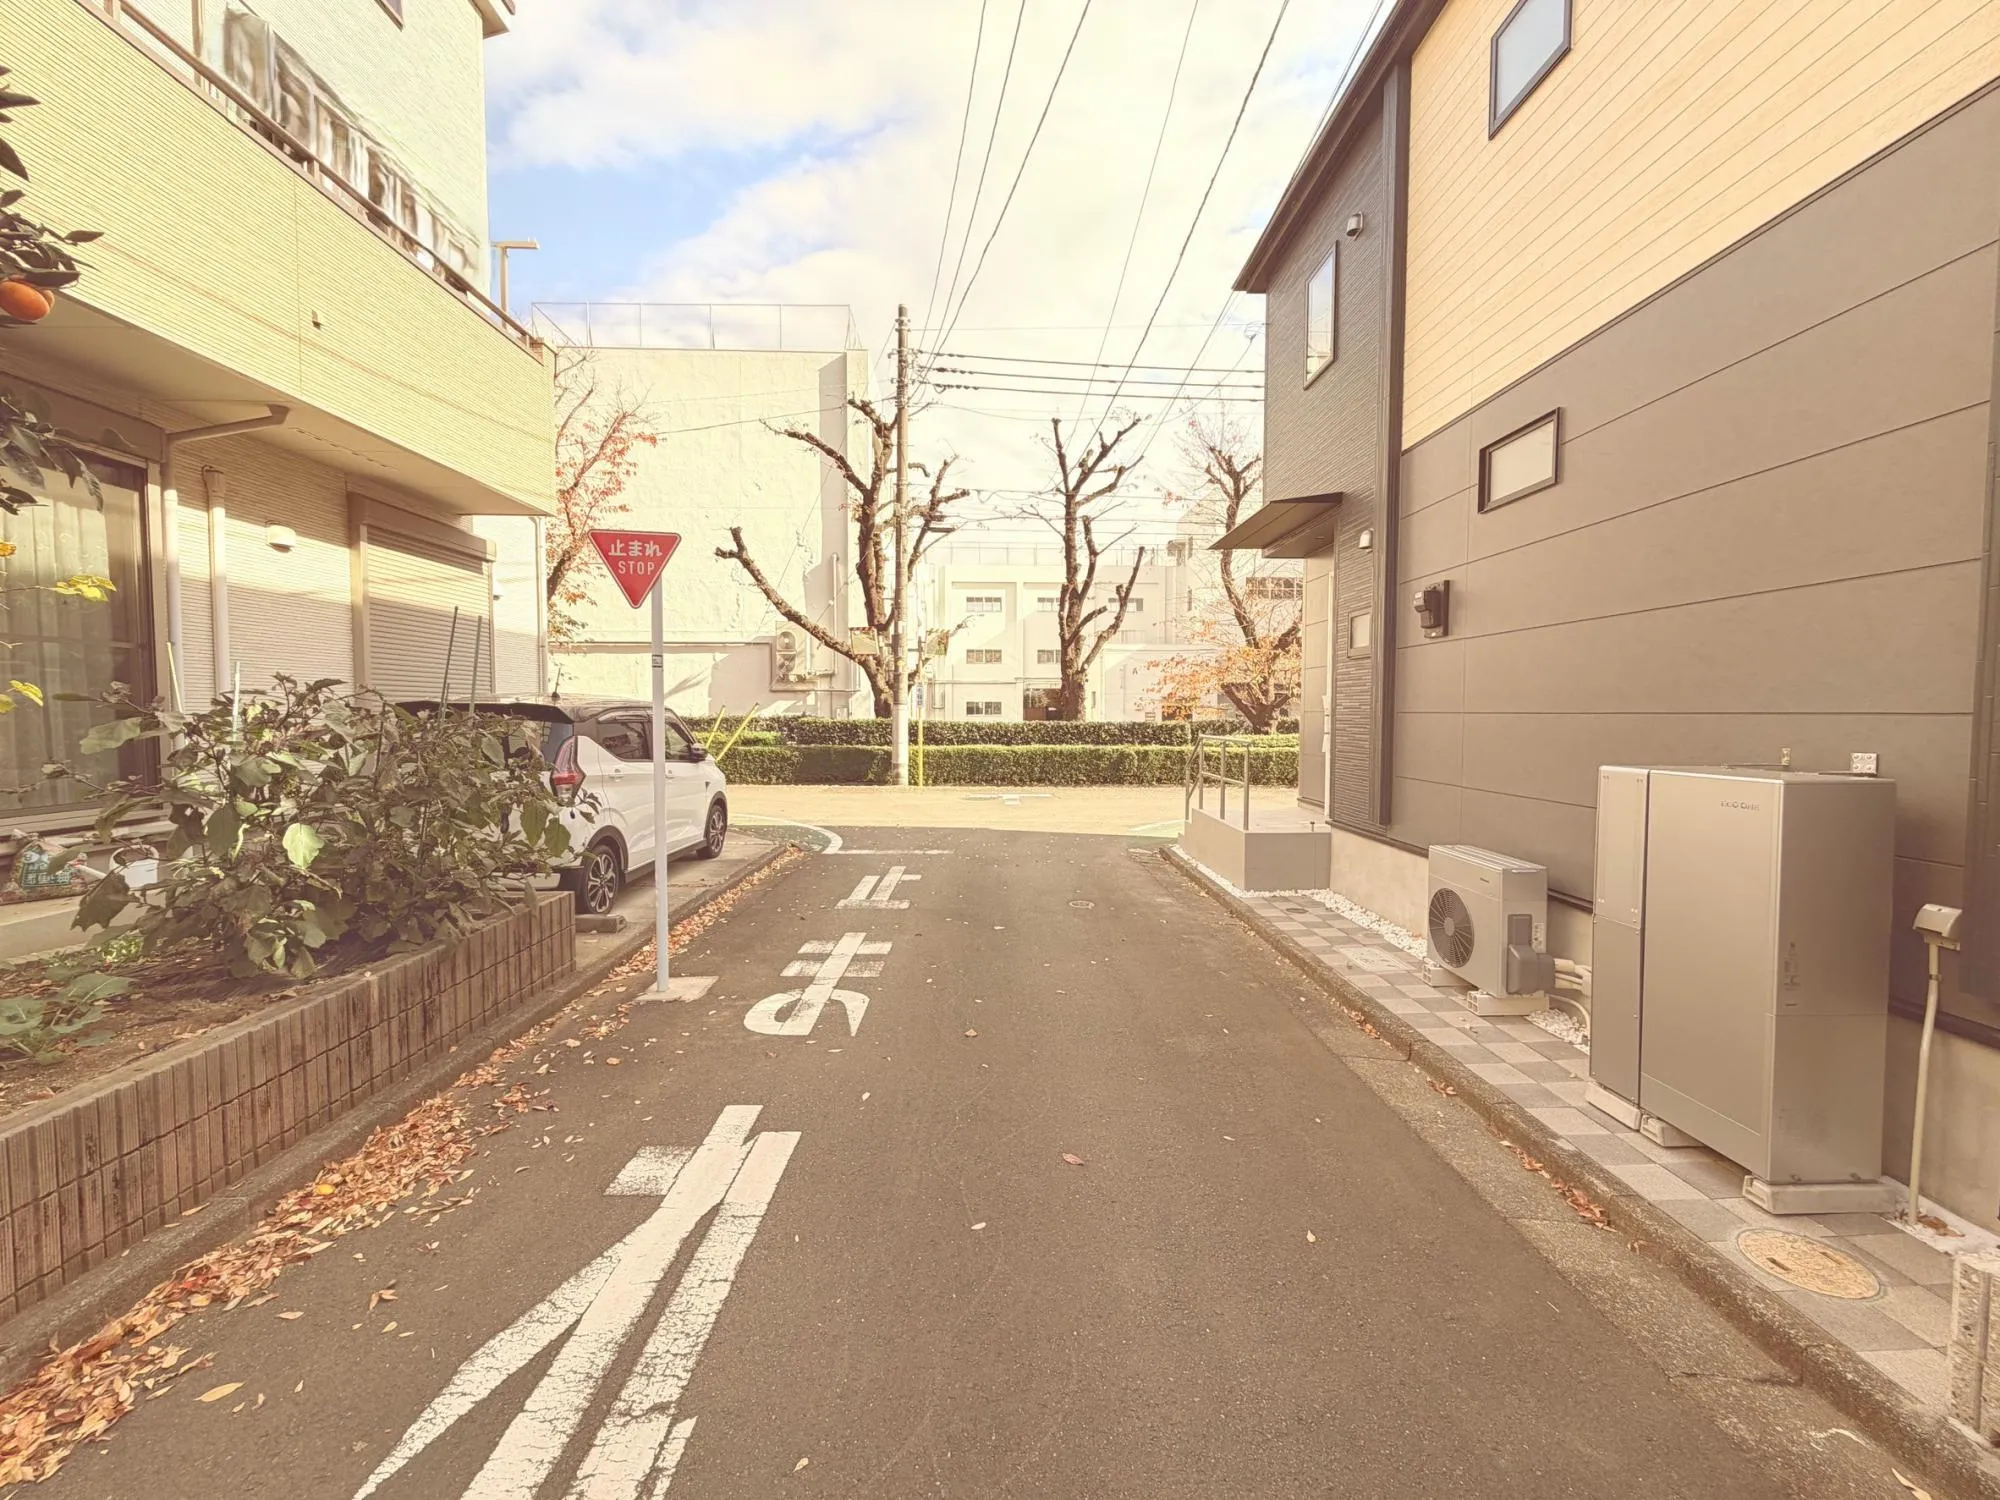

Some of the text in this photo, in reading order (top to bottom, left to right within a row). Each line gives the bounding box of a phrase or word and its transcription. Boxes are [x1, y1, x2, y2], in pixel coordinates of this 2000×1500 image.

[608, 539, 663, 557] 止まれ
[618, 560, 655, 575] STOP
[352, 865, 923, 1500] 止まれ
